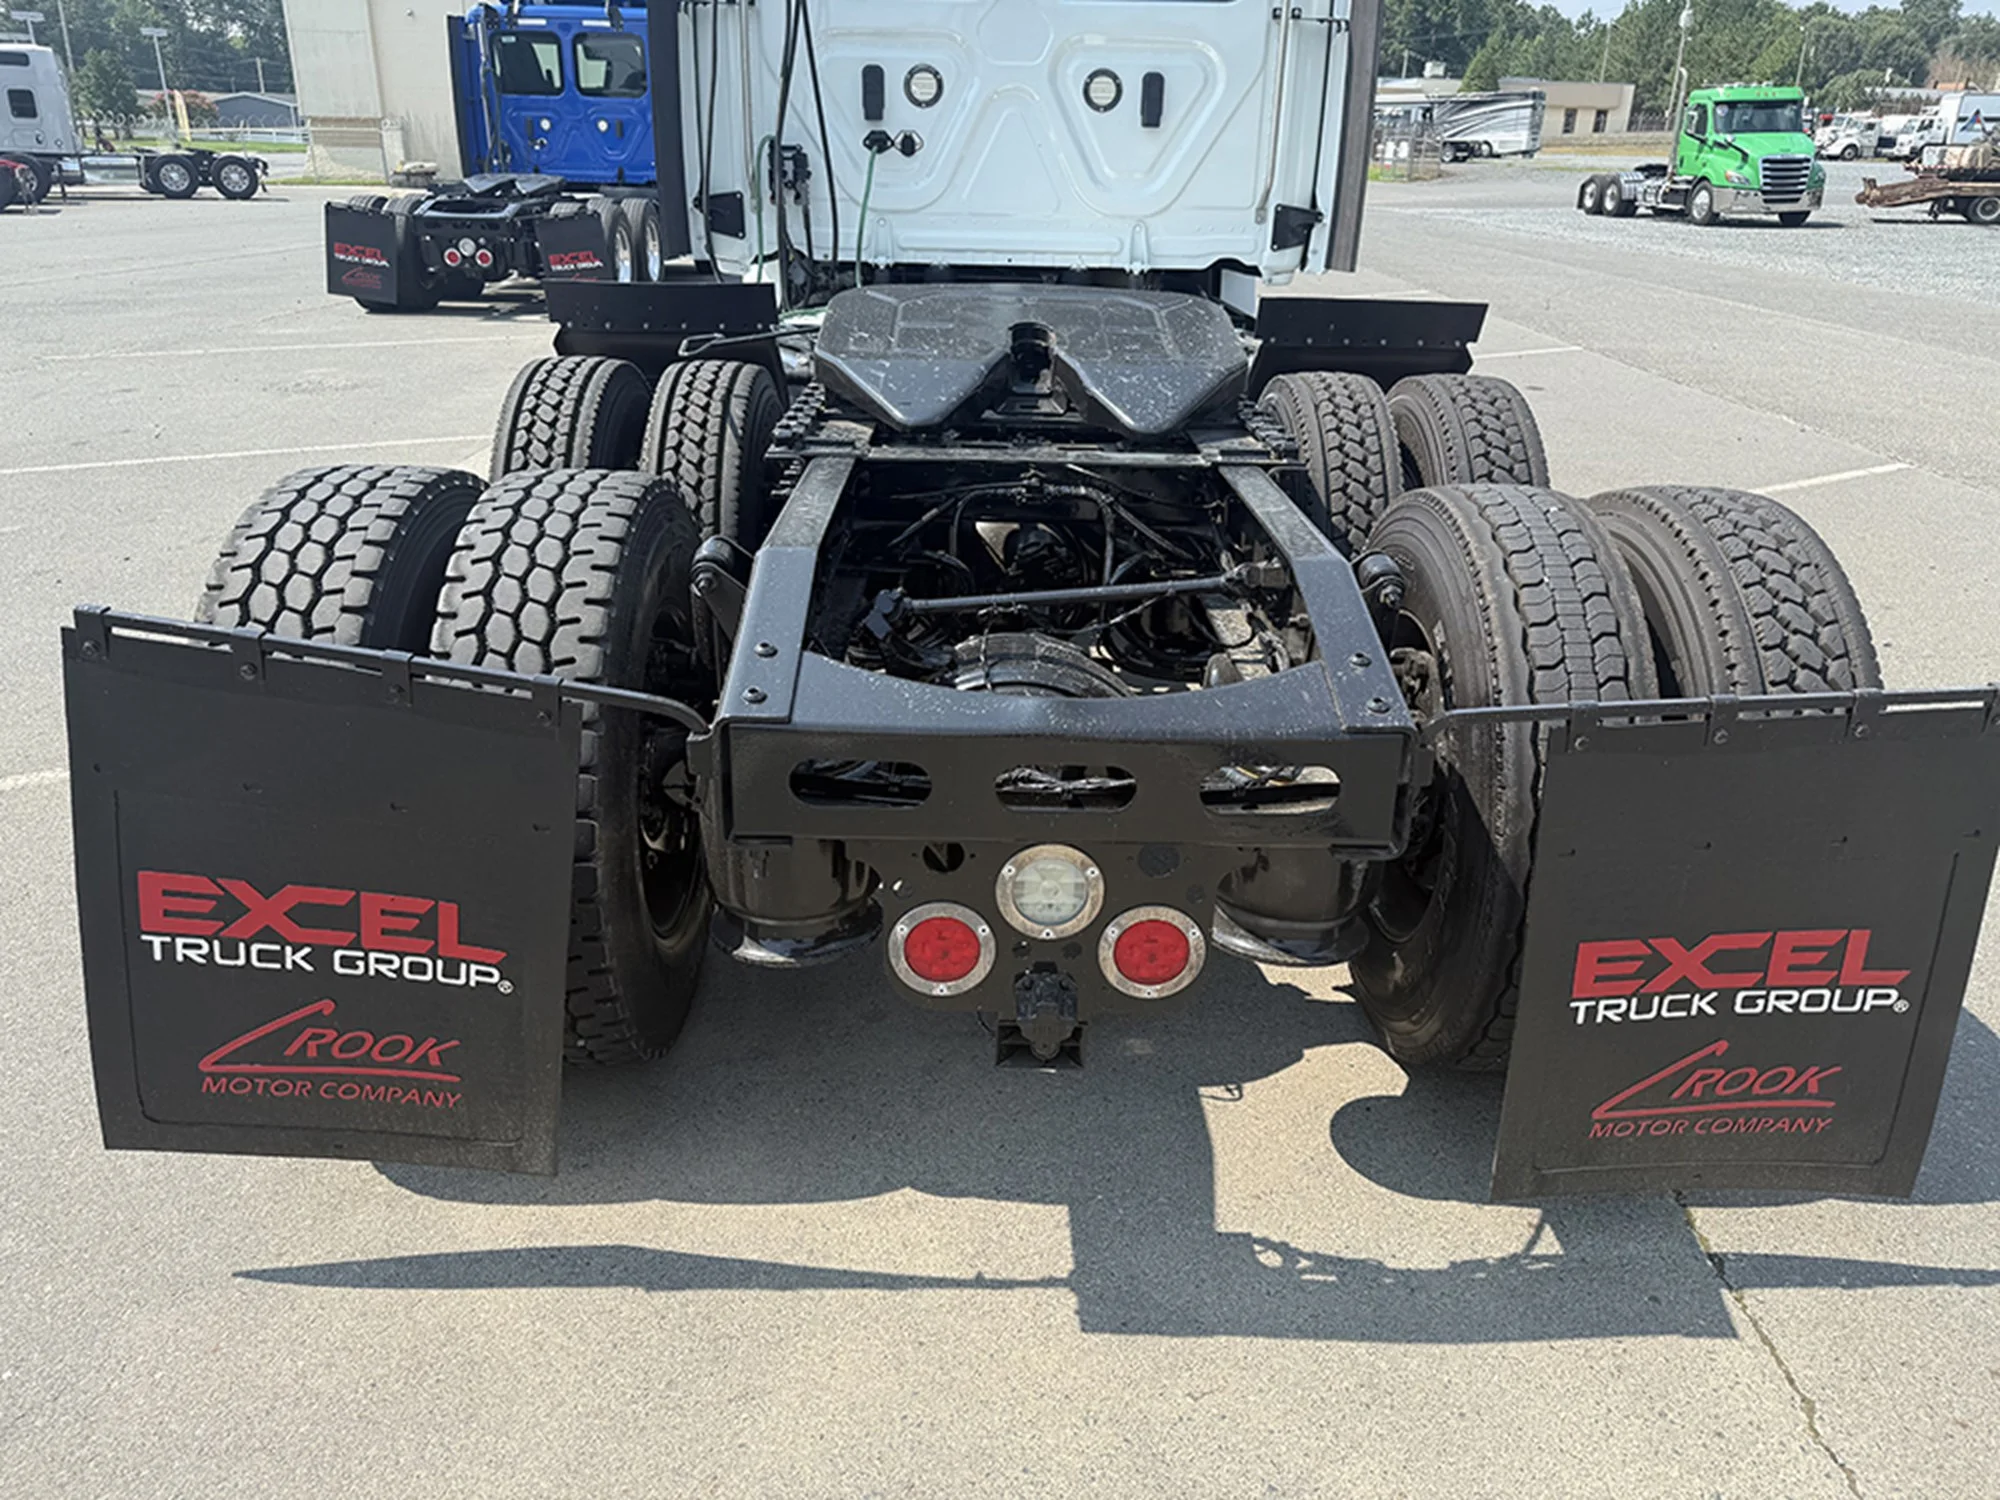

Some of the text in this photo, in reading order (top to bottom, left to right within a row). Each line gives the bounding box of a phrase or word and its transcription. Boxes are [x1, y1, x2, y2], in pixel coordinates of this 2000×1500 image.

[333, 242, 389, 261] EXCEL
[547, 250, 602, 266] EXCEL
[137, 870, 508, 965] EXCEL
[140, 934, 315, 972] TRUCK
[1571, 929, 1911, 998] EXCEL
[1569, 991, 1718, 1025] TRUCK
[201, 1076, 462, 1109] MOTOR COMPANY
[1588, 1117, 1834, 1140] MOTOR COMPANY
